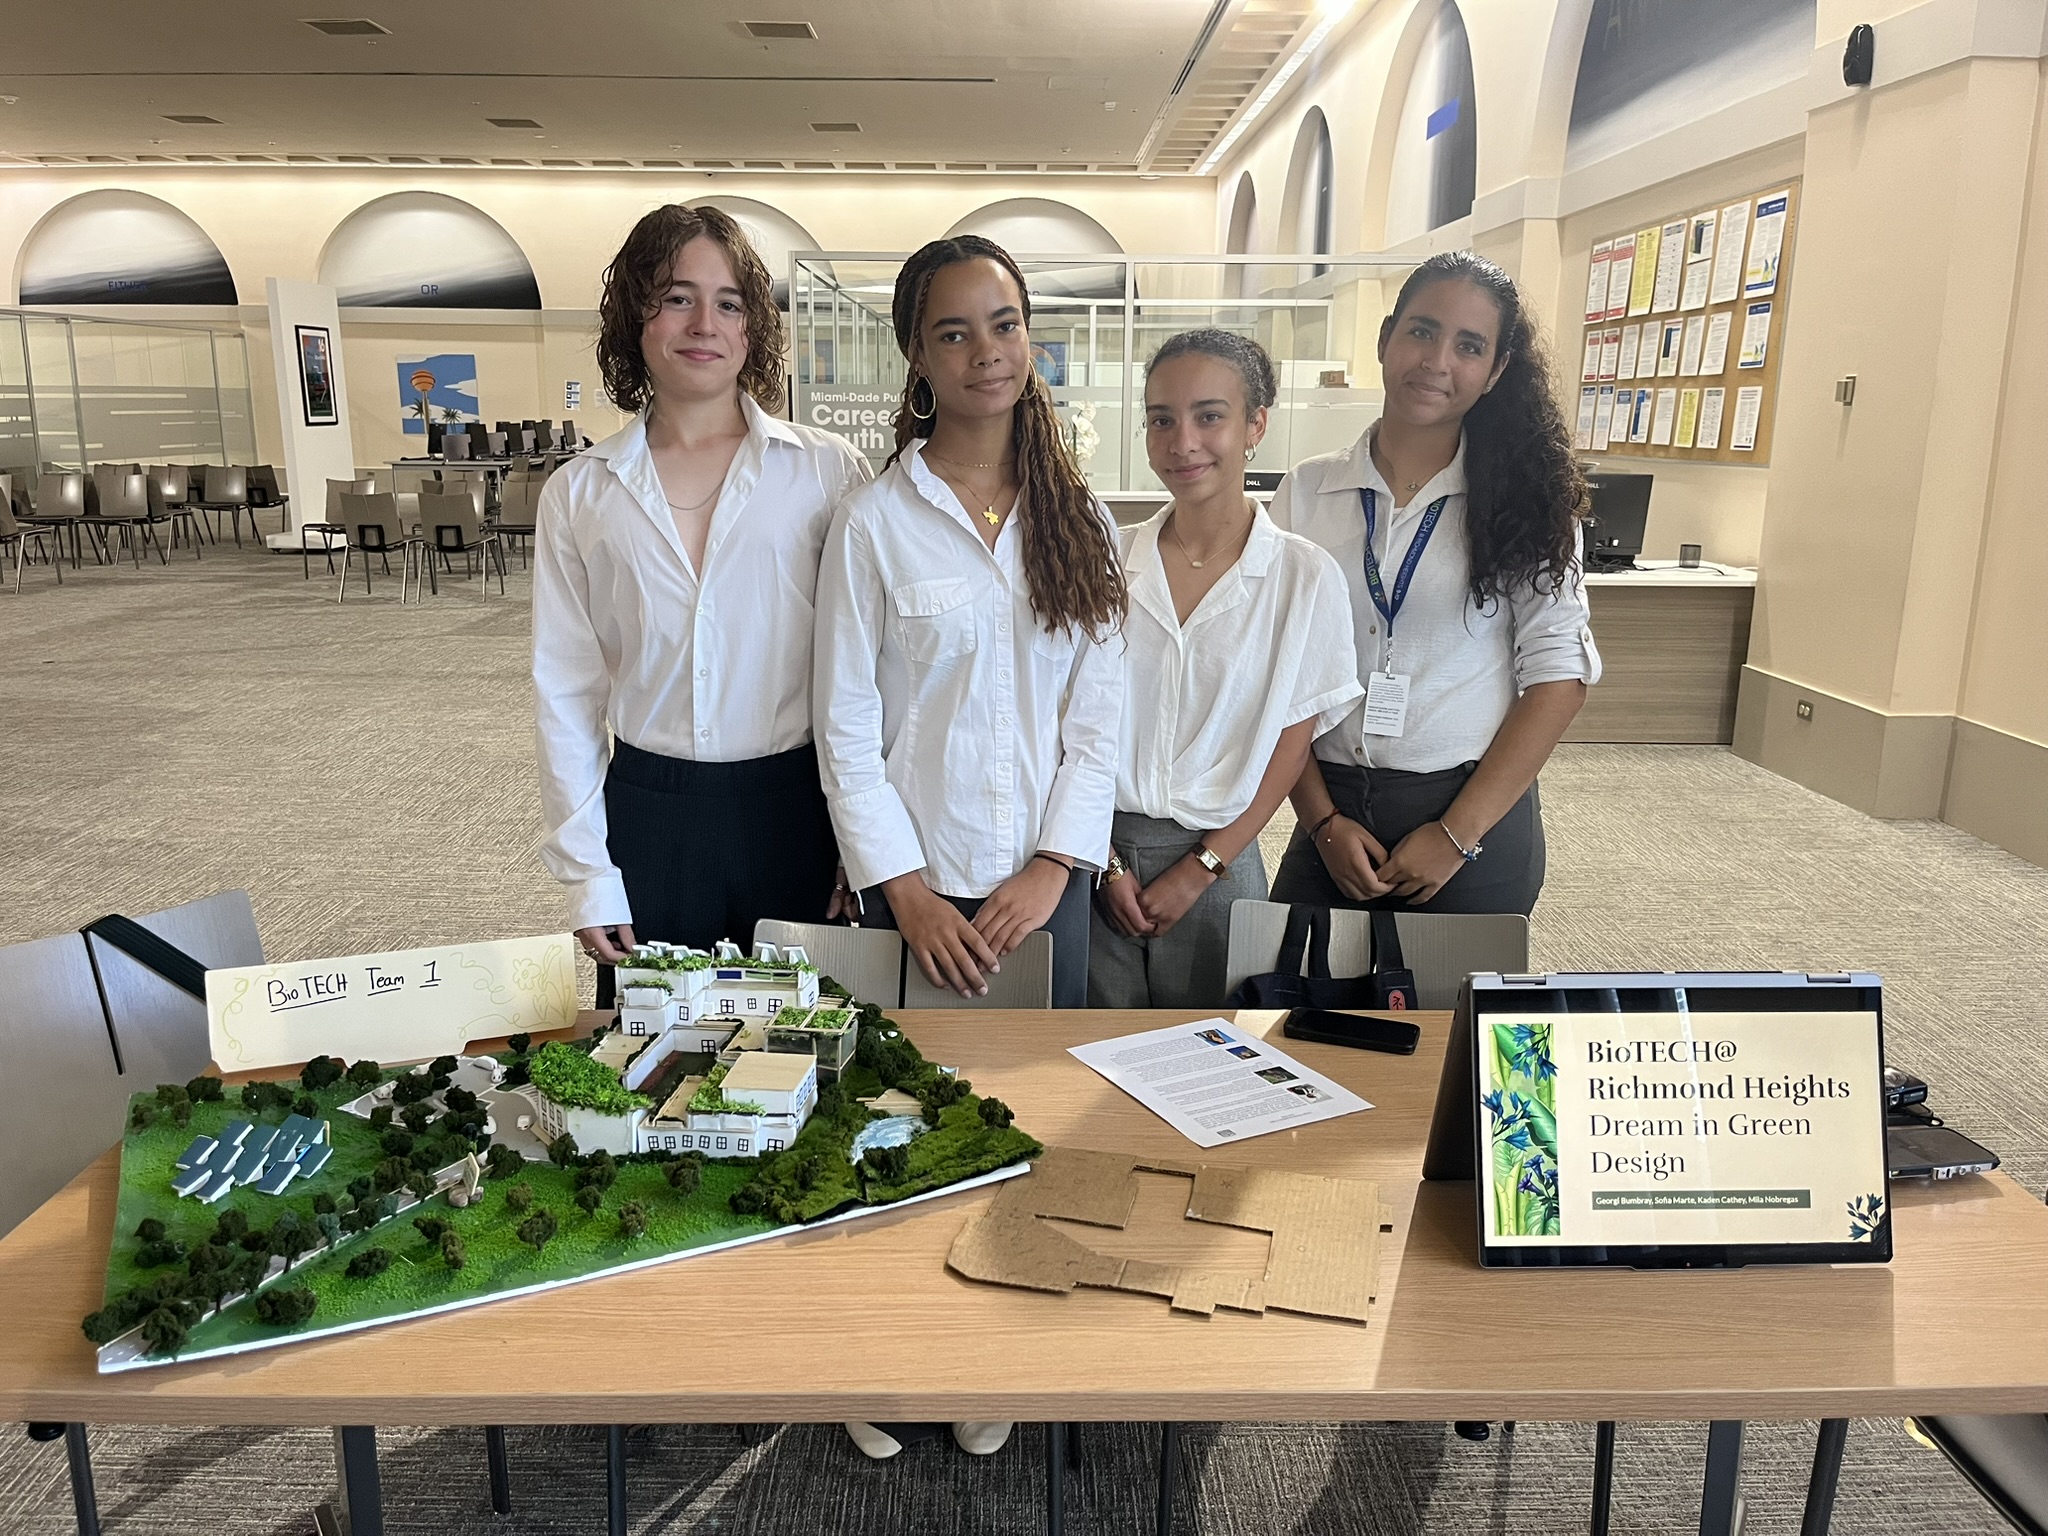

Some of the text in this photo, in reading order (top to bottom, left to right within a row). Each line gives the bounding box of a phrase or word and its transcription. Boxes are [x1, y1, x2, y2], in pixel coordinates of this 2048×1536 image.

[420, 284, 439, 295] OR
[810, 391, 880, 403] Miami-Dade
[811, 404, 891, 426] Caree
[844, 428, 885, 449] uth
[365, 966, 405, 989] Team
[423, 960, 442, 983] 1
[1586, 1039, 1738, 1064] BioTECH@
[1587, 1073, 1851, 1107] Richmond Heights
[1588, 1112, 1812, 1137] Dream in Green
[1590, 1150, 1687, 1181] Design
[1595, 1195, 1799, 1206] Georgi Bumbray, Sofia Marte, Kaden Cathey, Mila Nobregas
